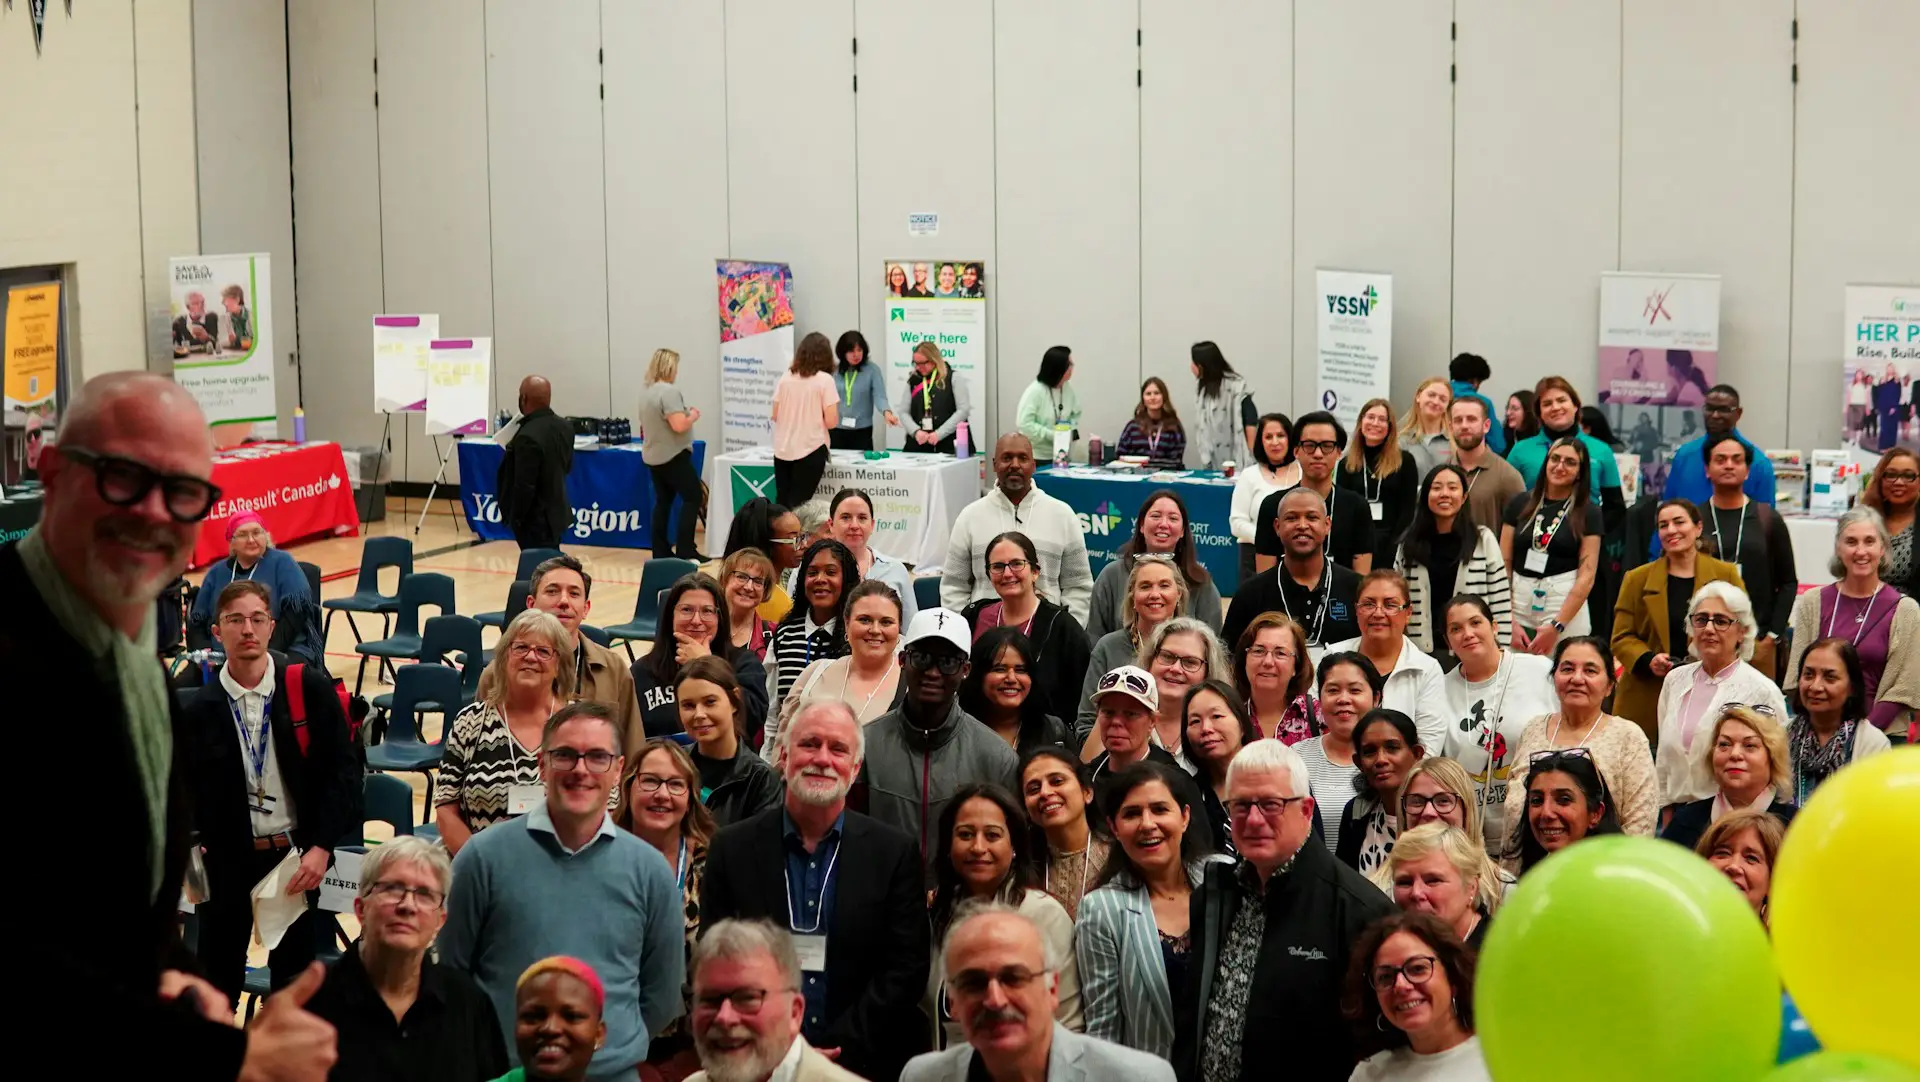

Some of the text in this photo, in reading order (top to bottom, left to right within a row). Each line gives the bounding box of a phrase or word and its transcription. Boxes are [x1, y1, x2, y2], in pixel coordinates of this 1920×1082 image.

[175, 272, 213, 281] ENERGY
[1326, 294, 1369, 317] YSSN
[900, 331, 968, 344] We're here
[1857, 323, 1920, 342] HER P
[940, 349, 956, 358] ou
[1857, 346, 1888, 359] Rise,
[203, 376, 228, 386] home
[229, 372, 270, 386] upgrades
[823, 468, 897, 481] adian Mental
[202, 475, 328, 520] LEAResult Canada
[815, 484, 909, 497] alth ociation
[472, 493, 642, 538] Yo gion
[876, 519, 908, 533] for all
[1078, 512, 1109, 536] SN
[1190, 522, 1210, 534] ORT
[1194, 535, 1233, 547] TWORK
[644, 685, 676, 711] EAS
[1475, 784, 1508, 806] ICK
